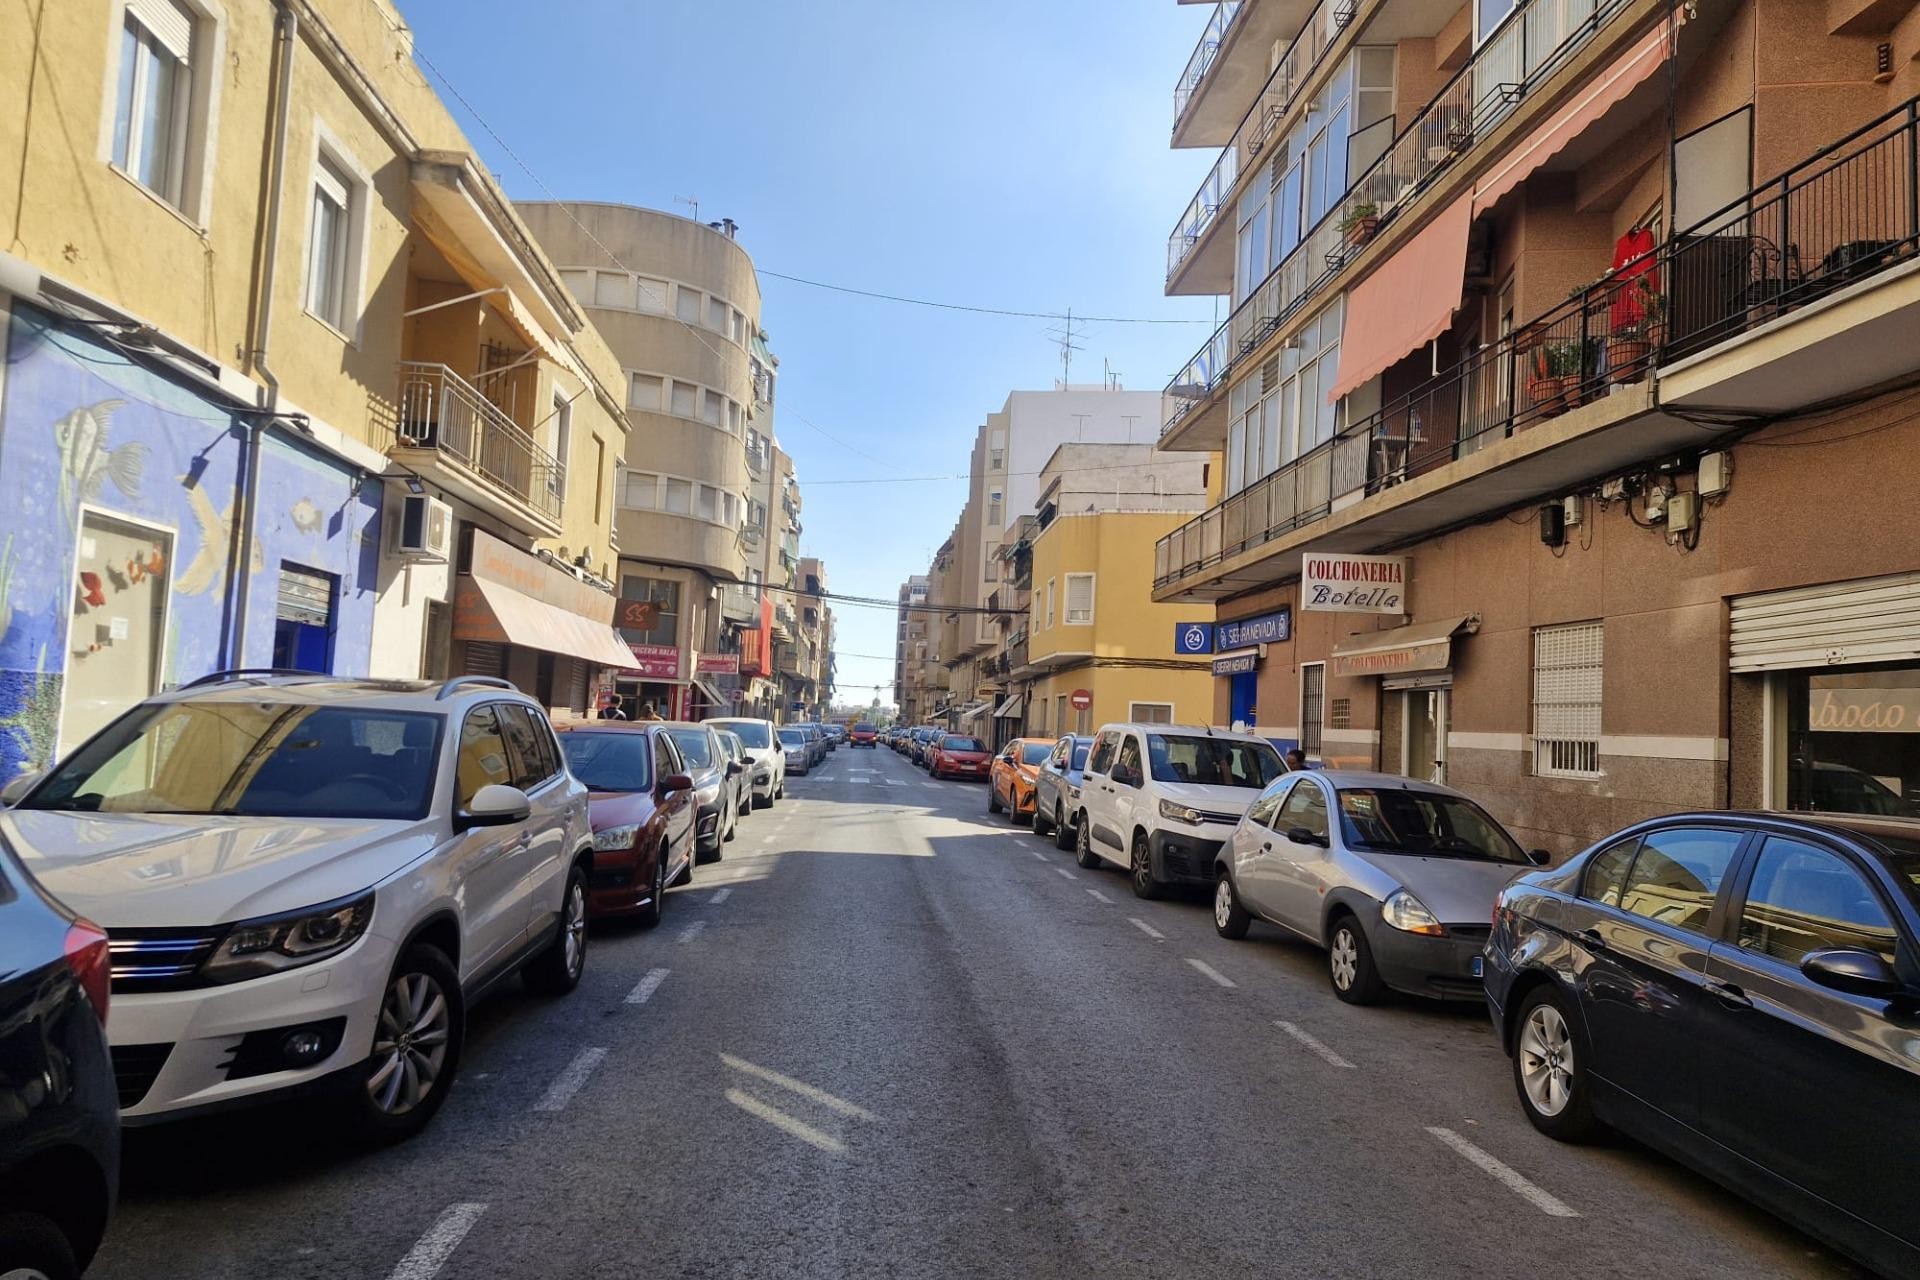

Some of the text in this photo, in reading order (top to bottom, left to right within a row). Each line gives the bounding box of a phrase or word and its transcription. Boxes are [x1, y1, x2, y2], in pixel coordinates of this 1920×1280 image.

[1308, 560, 1402, 583] COLCHONERIA
[1312, 584, 1399, 608] Botella
[1188, 633, 1200, 643] 24
